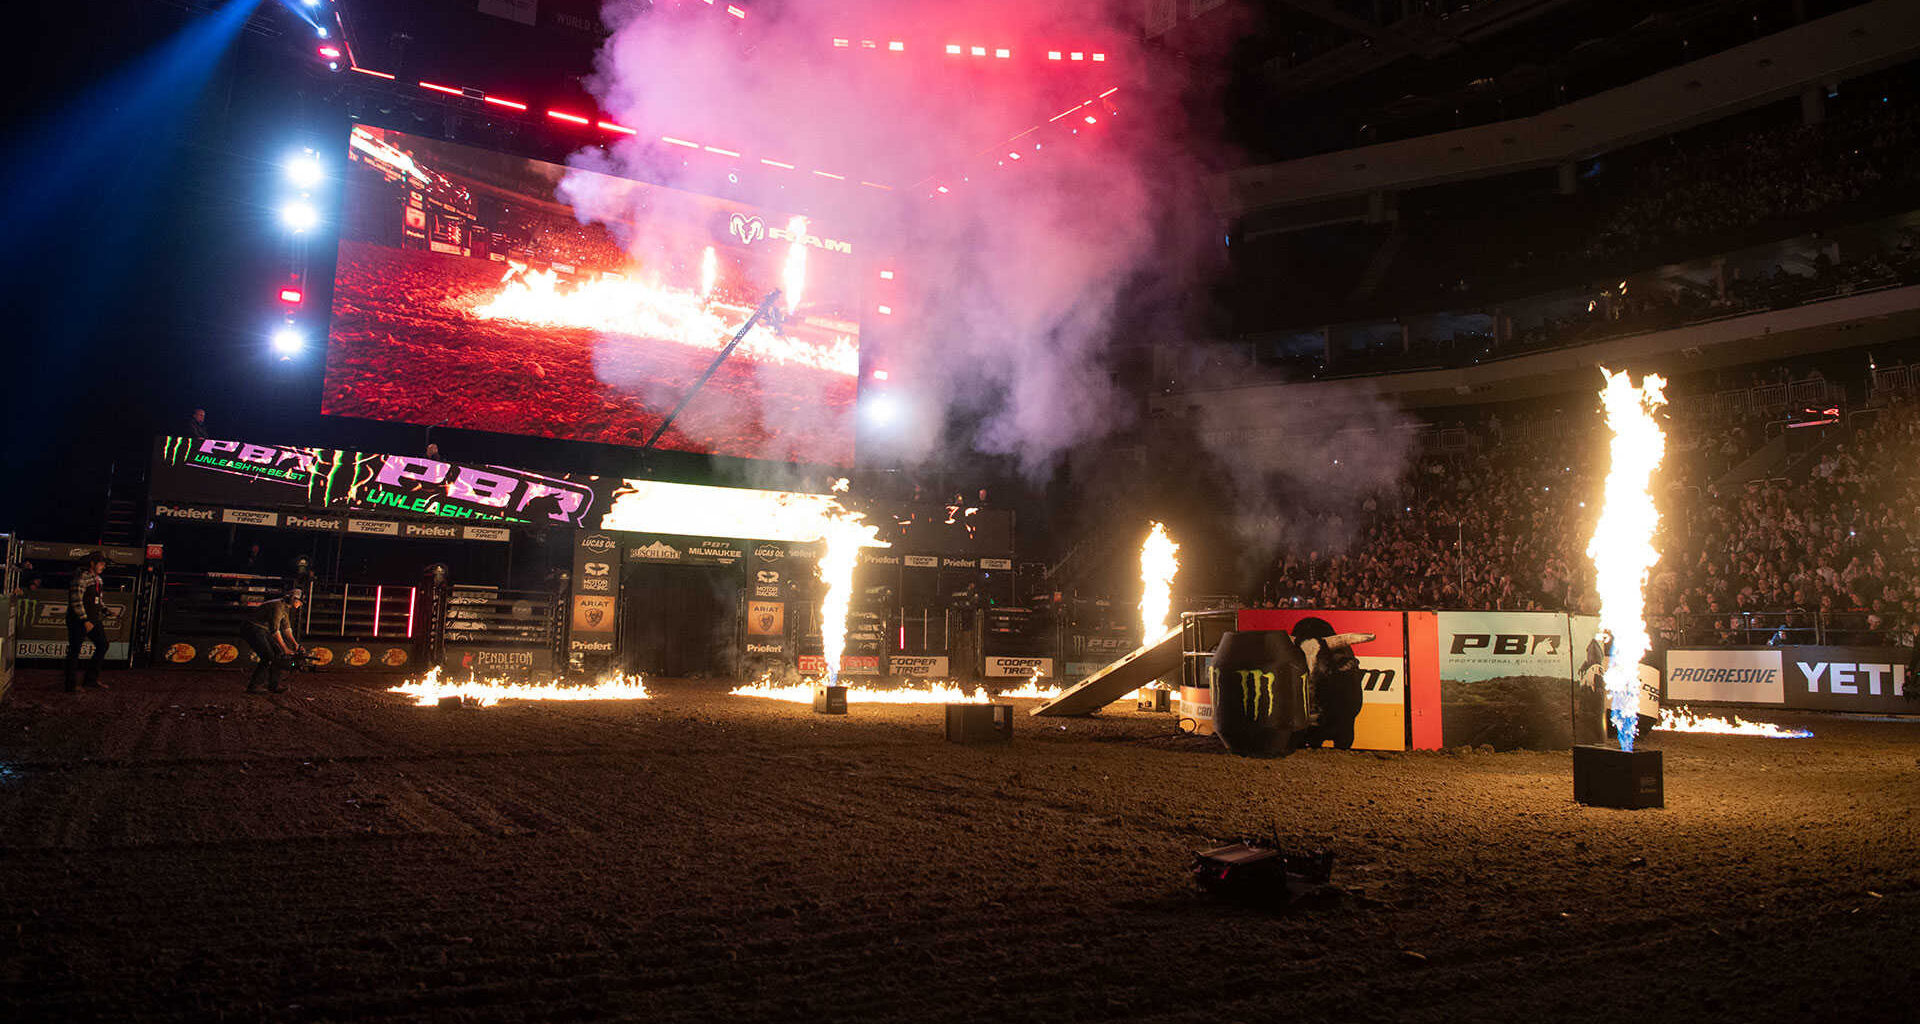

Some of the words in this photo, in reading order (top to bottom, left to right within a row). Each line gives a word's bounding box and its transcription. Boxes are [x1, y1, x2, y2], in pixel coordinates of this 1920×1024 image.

[199, 438, 314, 472] PBR
[194, 454, 251, 472] UNLEASH
[251, 465, 267, 474] THE
[267, 468, 306, 481] BEAST
[375, 455, 584, 522] PBR
[366, 489, 475, 518] UNLEASH
[155, 505, 215, 520] Priefert
[286, 515, 340, 530] Priefert
[406, 524, 457, 537] Priefert
[581, 539, 604, 548] LUCAS
[605, 540, 616, 549] OIL
[688, 547, 743, 558] MILWAUKEE
[754, 548, 775, 557] LUCAS
[775, 550, 785, 558] OIL
[863, 555, 899, 565] Priefert
[943, 557, 976, 567] Priefert
[19, 643, 63, 656] BUSCH
[571, 640, 613, 651] Priefert
[747, 643, 783, 653] Priefert
[1450, 634, 1561, 655] PBR
[478, 651, 533, 665] PENDLETON
[889, 657, 937, 666] COOPER
[997, 659, 1042, 667] COOPER
[895, 665, 929, 674] TIRES
[1670, 667, 1777, 684] PROGRESSIVE
[1797, 661, 1905, 696] YETI
